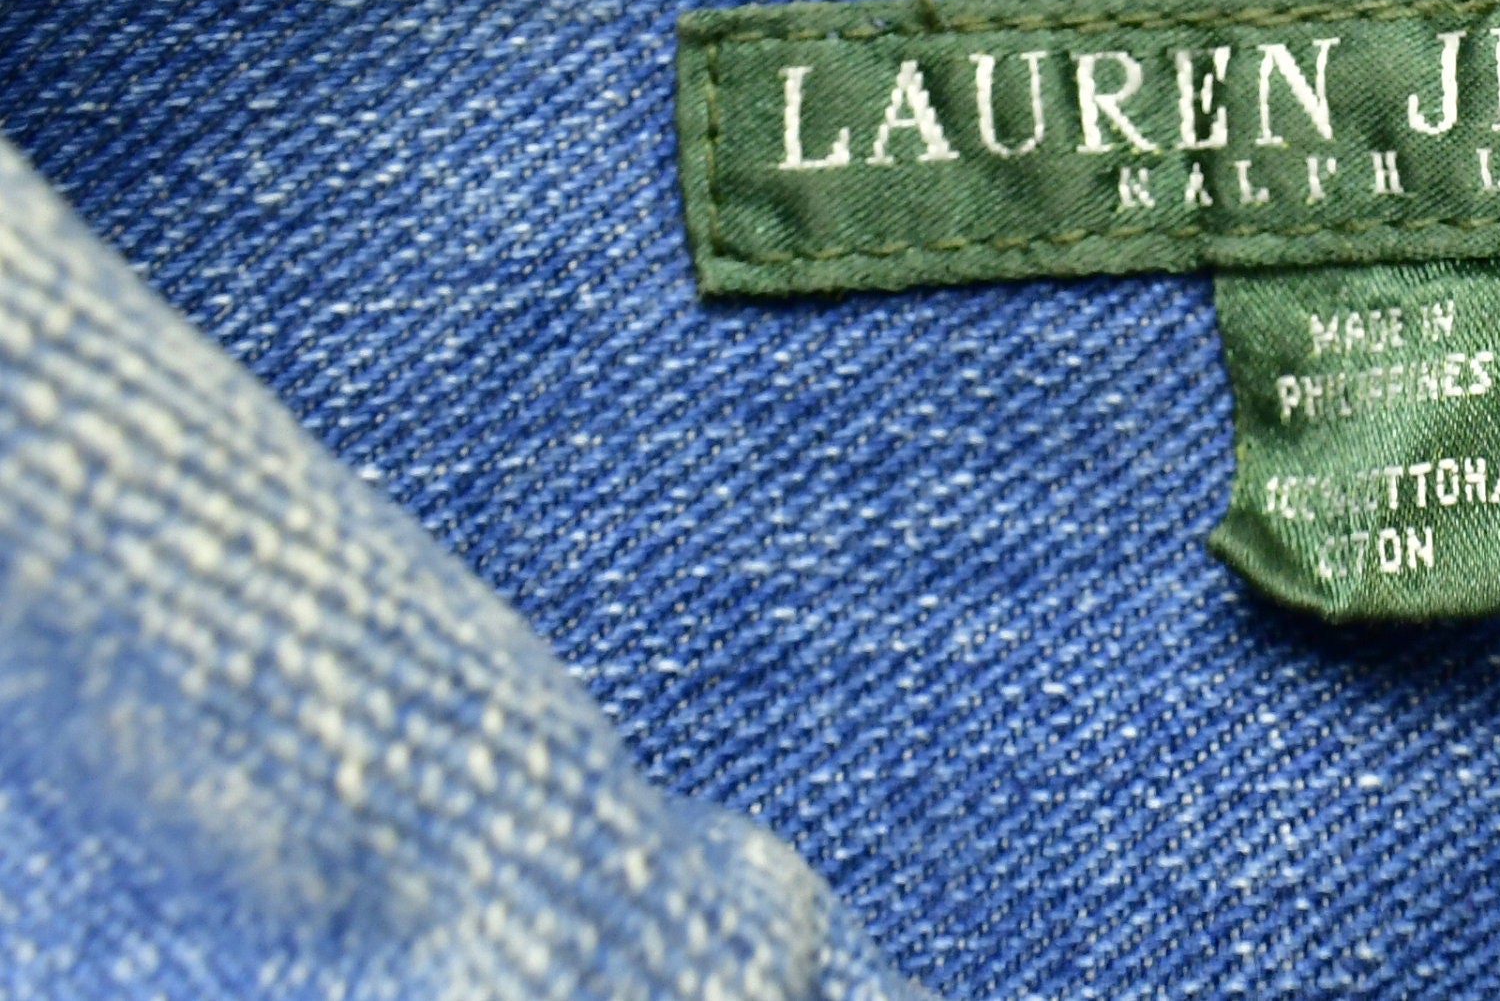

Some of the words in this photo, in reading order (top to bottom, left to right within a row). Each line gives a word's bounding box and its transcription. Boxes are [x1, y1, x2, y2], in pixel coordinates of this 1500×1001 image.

[778, 36, 1340, 171] LAUREN
[1309, 307, 1403, 356] MADE
[1421, 298, 1454, 342] IN
